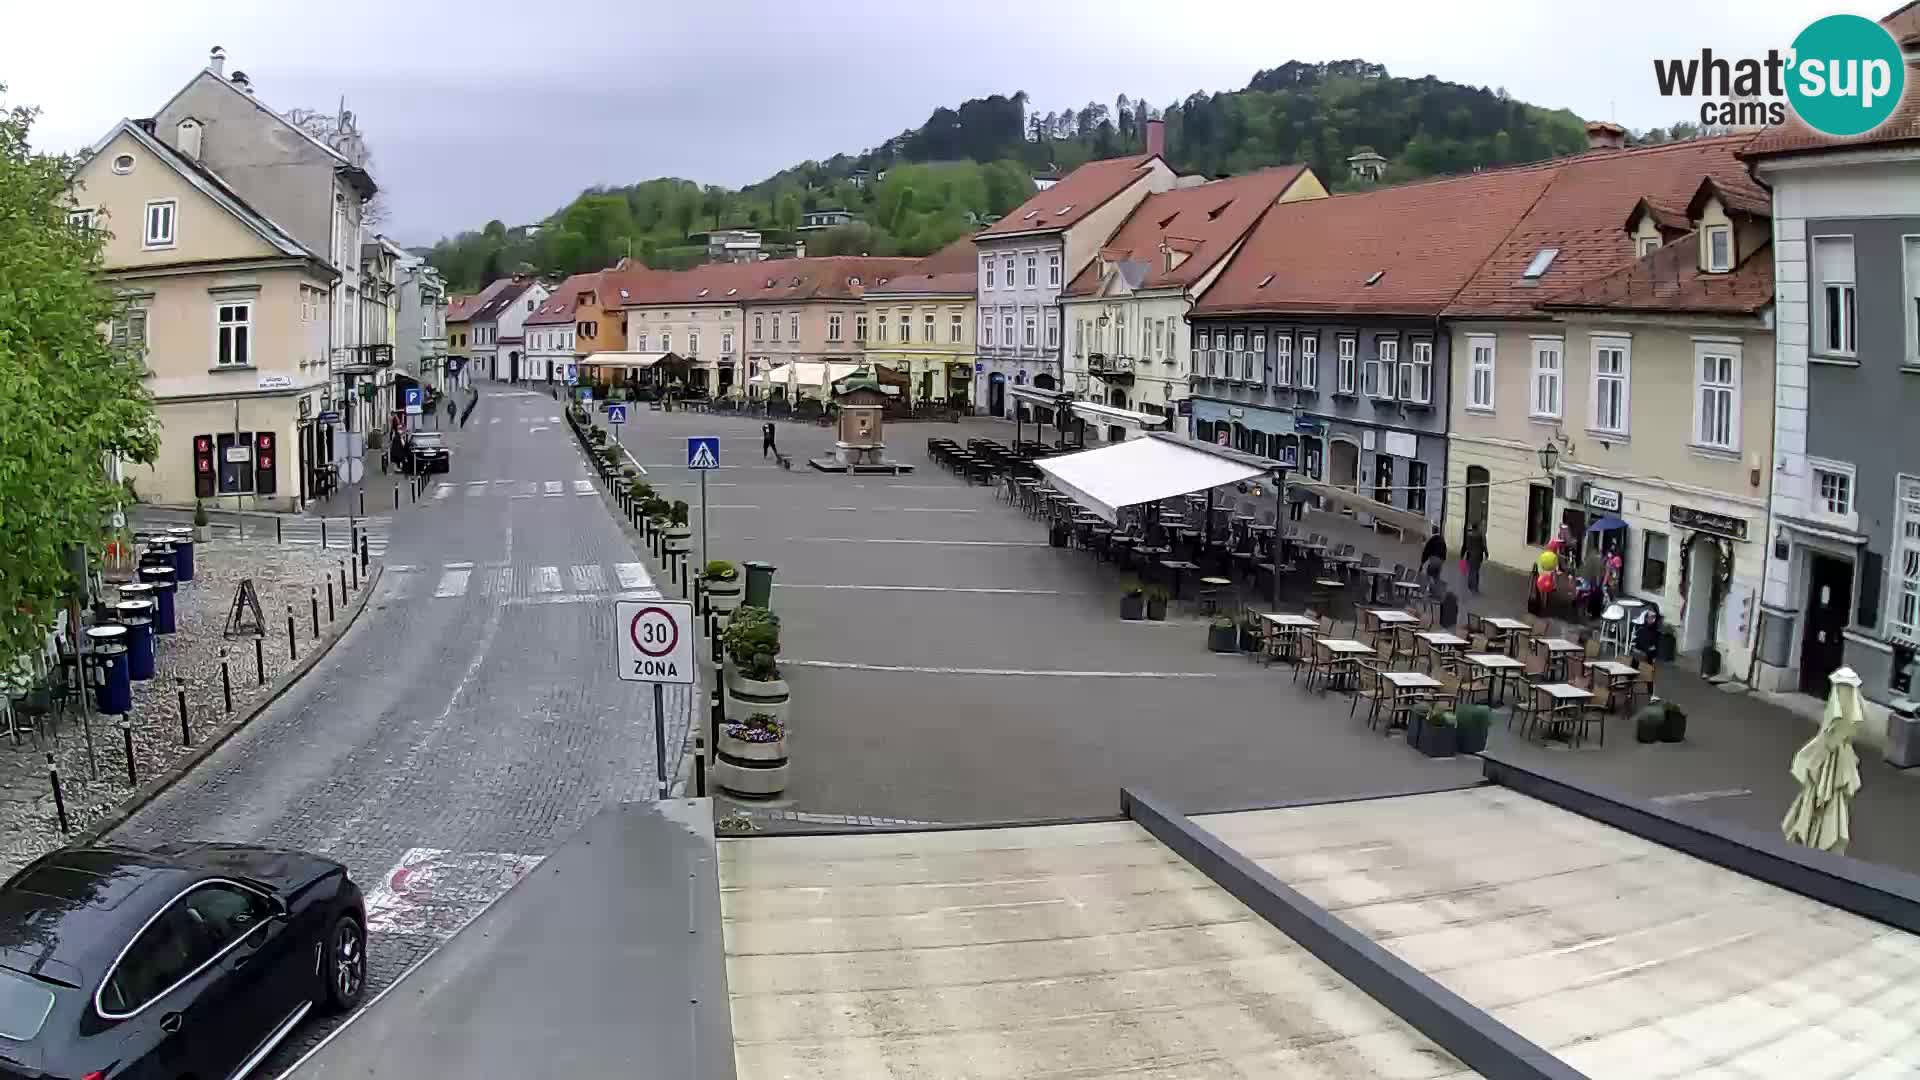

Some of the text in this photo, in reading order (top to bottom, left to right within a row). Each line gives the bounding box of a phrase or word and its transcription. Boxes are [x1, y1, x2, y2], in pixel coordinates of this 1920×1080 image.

[410, 392, 418, 403] P
[643, 622, 667, 643] 30
[634, 660, 678, 676] ZONA
